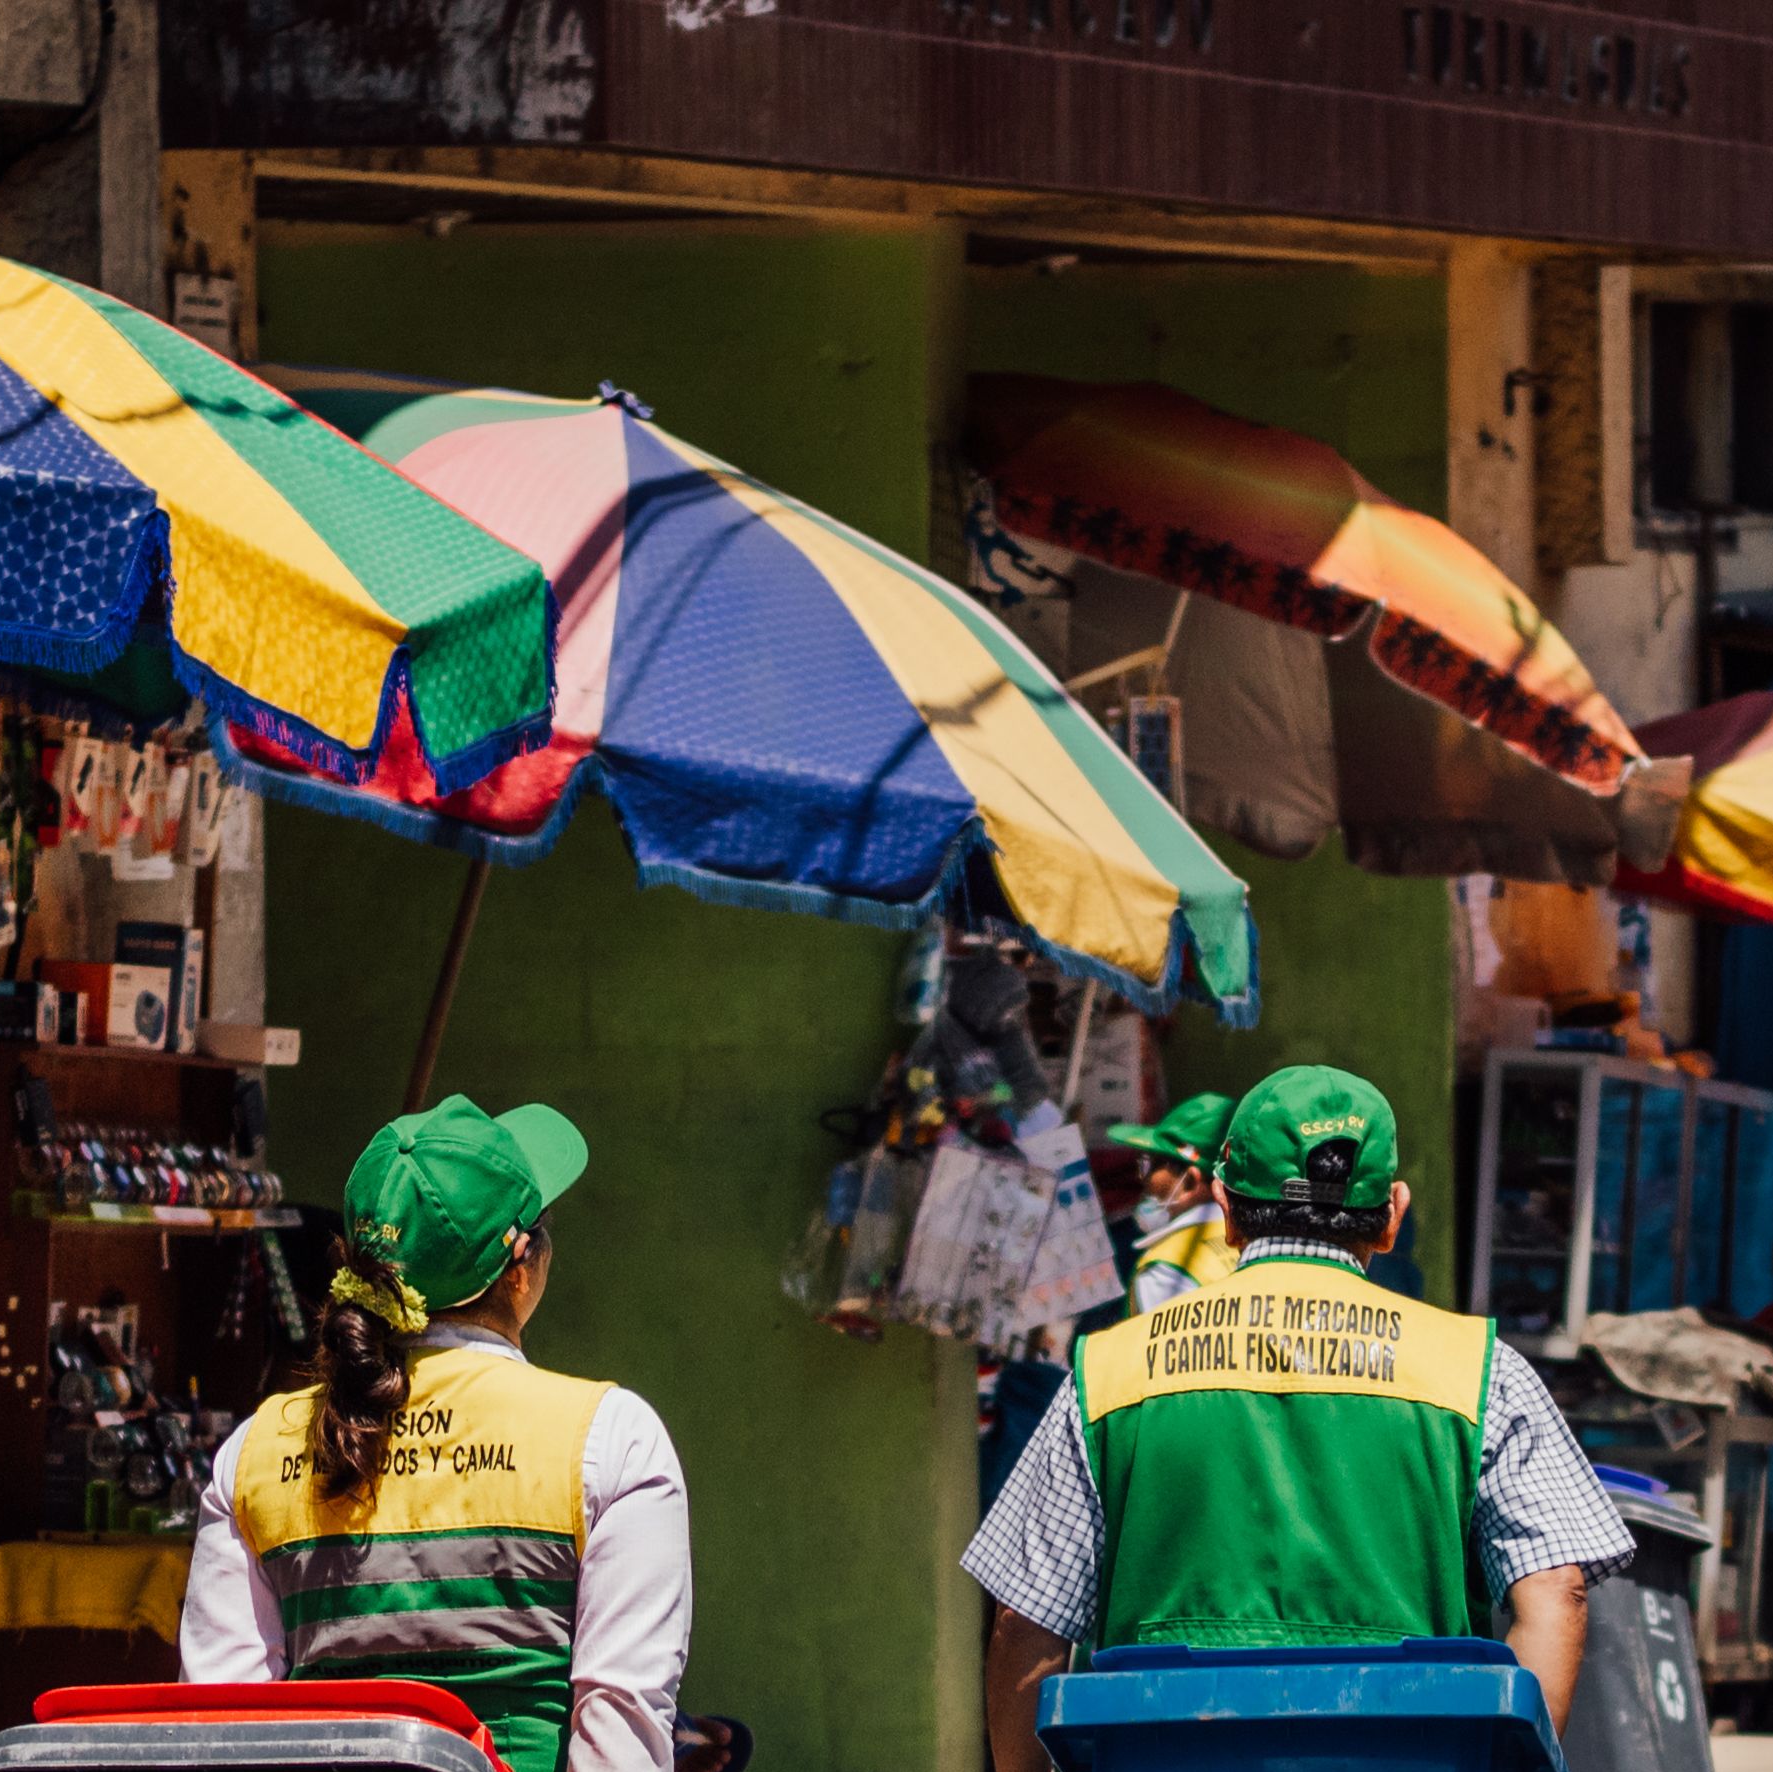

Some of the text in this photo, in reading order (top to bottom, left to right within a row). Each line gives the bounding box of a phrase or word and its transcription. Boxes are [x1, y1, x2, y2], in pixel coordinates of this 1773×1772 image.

[1149, 1292, 1402, 1341] DIVISIÓN DE MERCADOS
[1146, 1335, 1396, 1383] Y CAMAL FISCALIZADOR
[387, 1401, 453, 1438] ISIÓN
[281, 1454, 303, 1484] DE
[430, 1446, 442, 1473] Y
[453, 1443, 518, 1475] CAMAL
